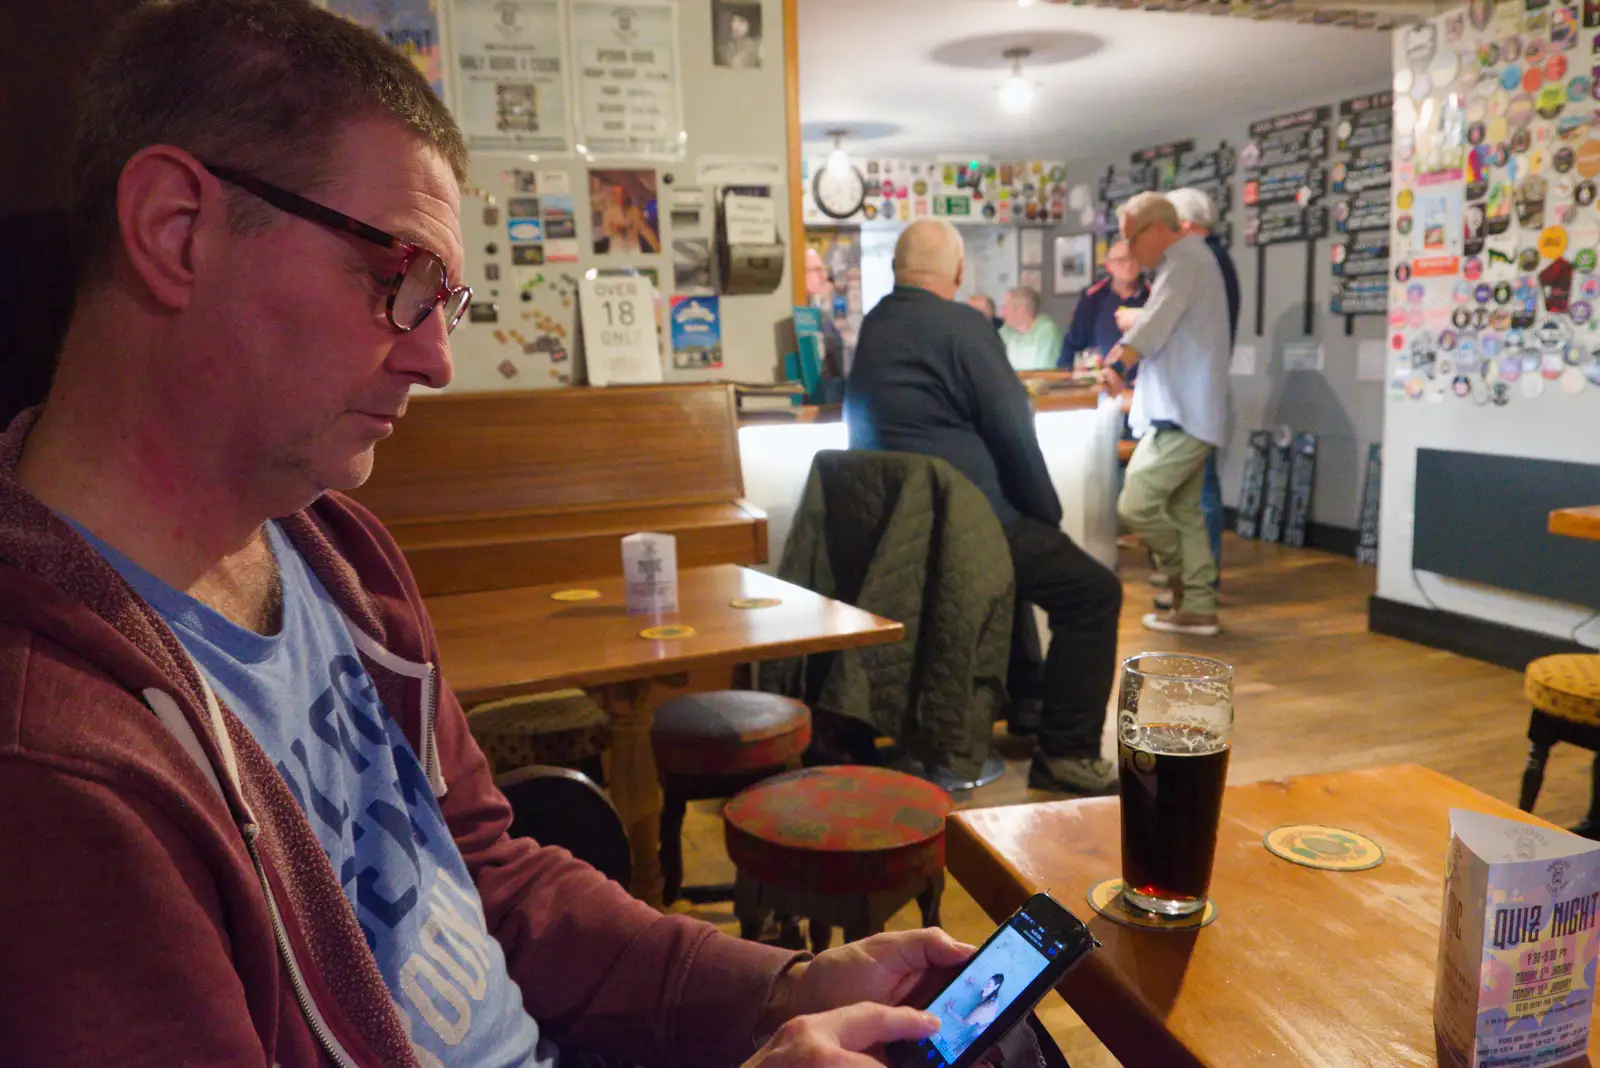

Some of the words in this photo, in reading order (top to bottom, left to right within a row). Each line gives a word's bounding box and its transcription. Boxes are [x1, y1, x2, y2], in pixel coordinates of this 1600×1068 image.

[594, 283, 638, 296] OVER
[602, 301, 635, 326] 18
[1493, 905, 1542, 949] QUIZ
[1551, 892, 1600, 939] NIGHT
